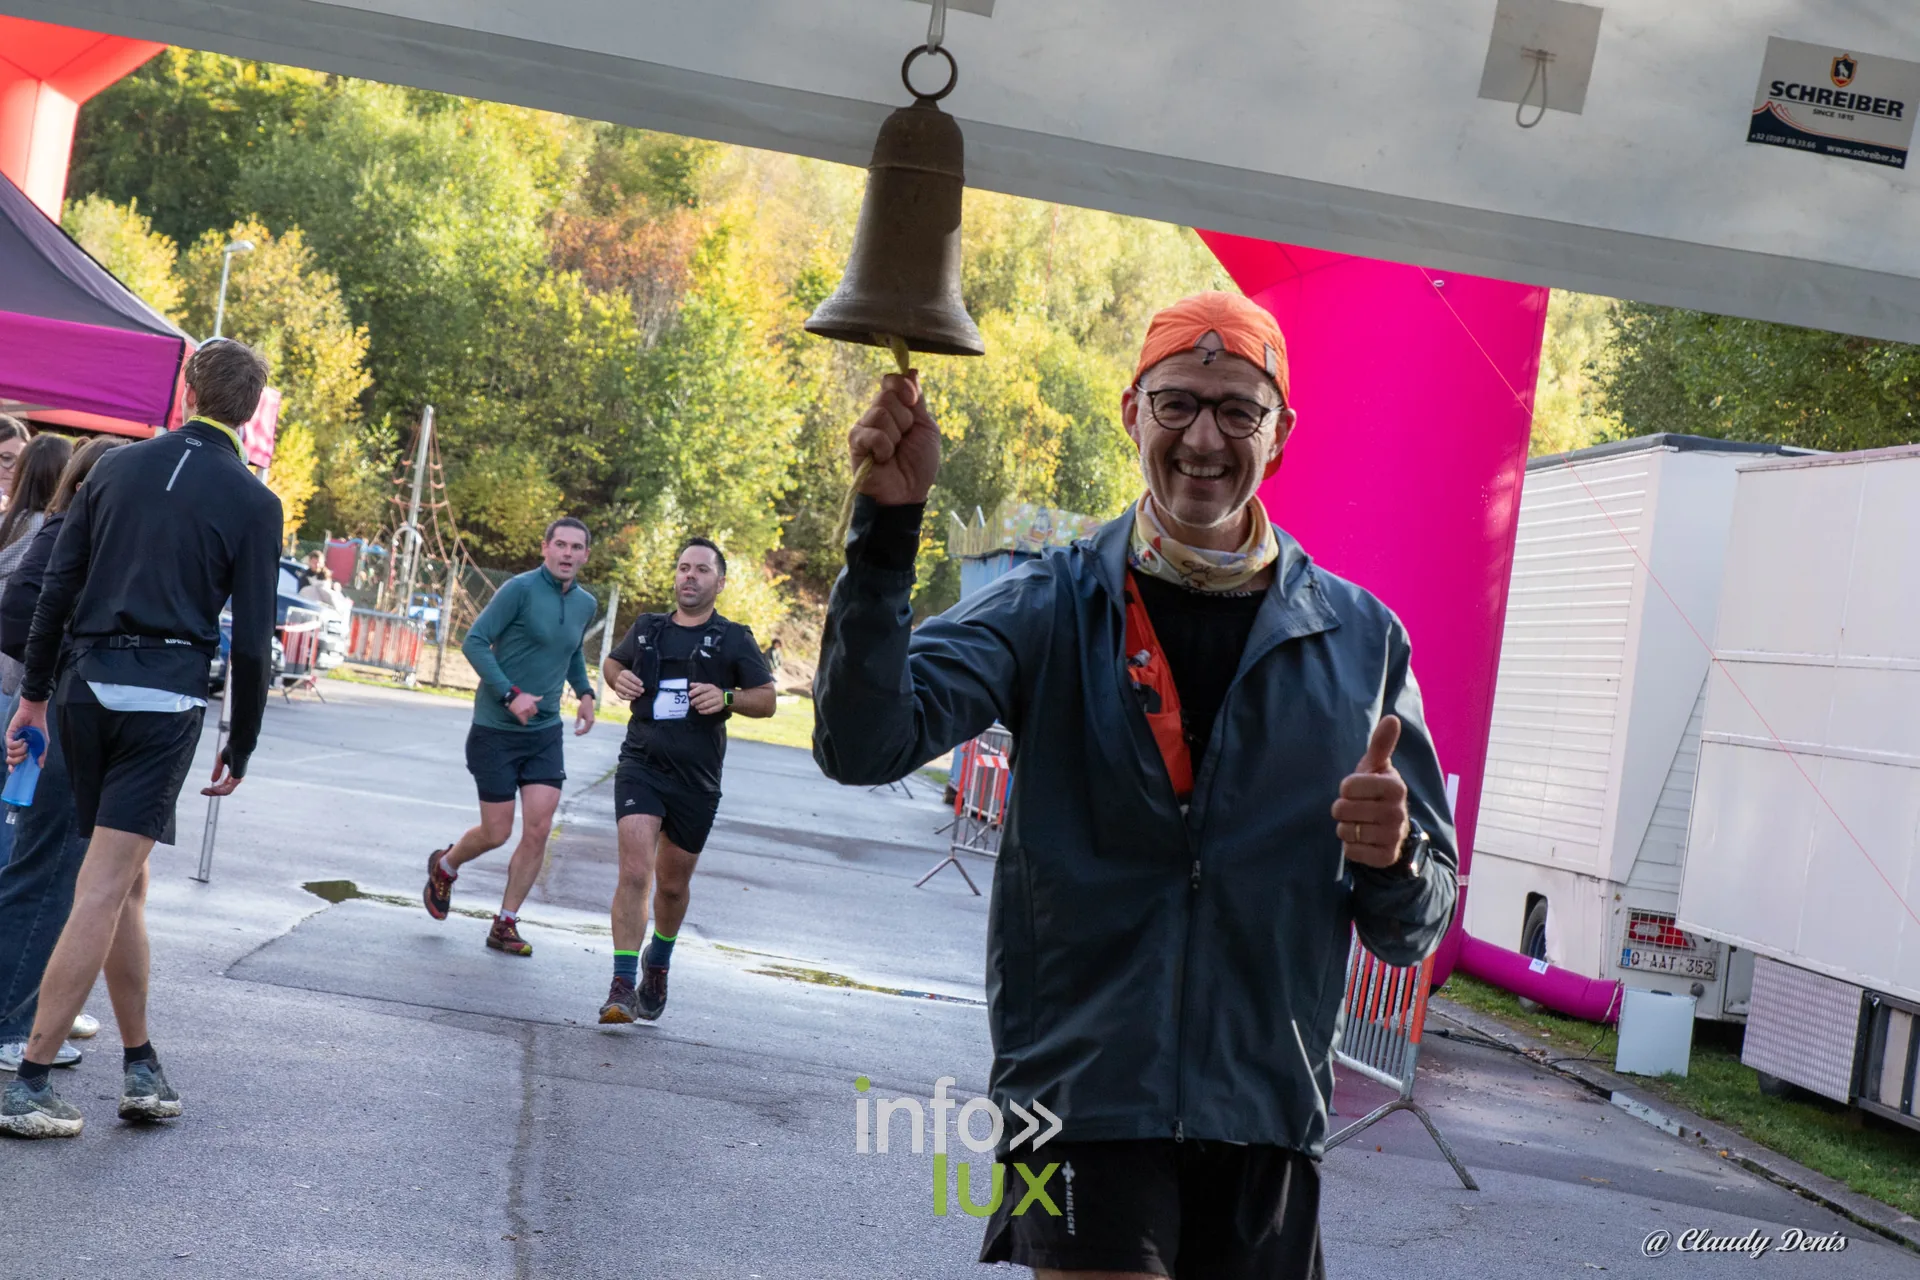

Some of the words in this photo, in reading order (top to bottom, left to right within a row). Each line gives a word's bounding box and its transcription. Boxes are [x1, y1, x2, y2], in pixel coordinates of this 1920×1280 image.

[1769, 80, 1905, 118] SCHREIBER
[1812, 108, 1836, 118] SINCE
[1826, 144, 1903, 165] www.schreiber.be
